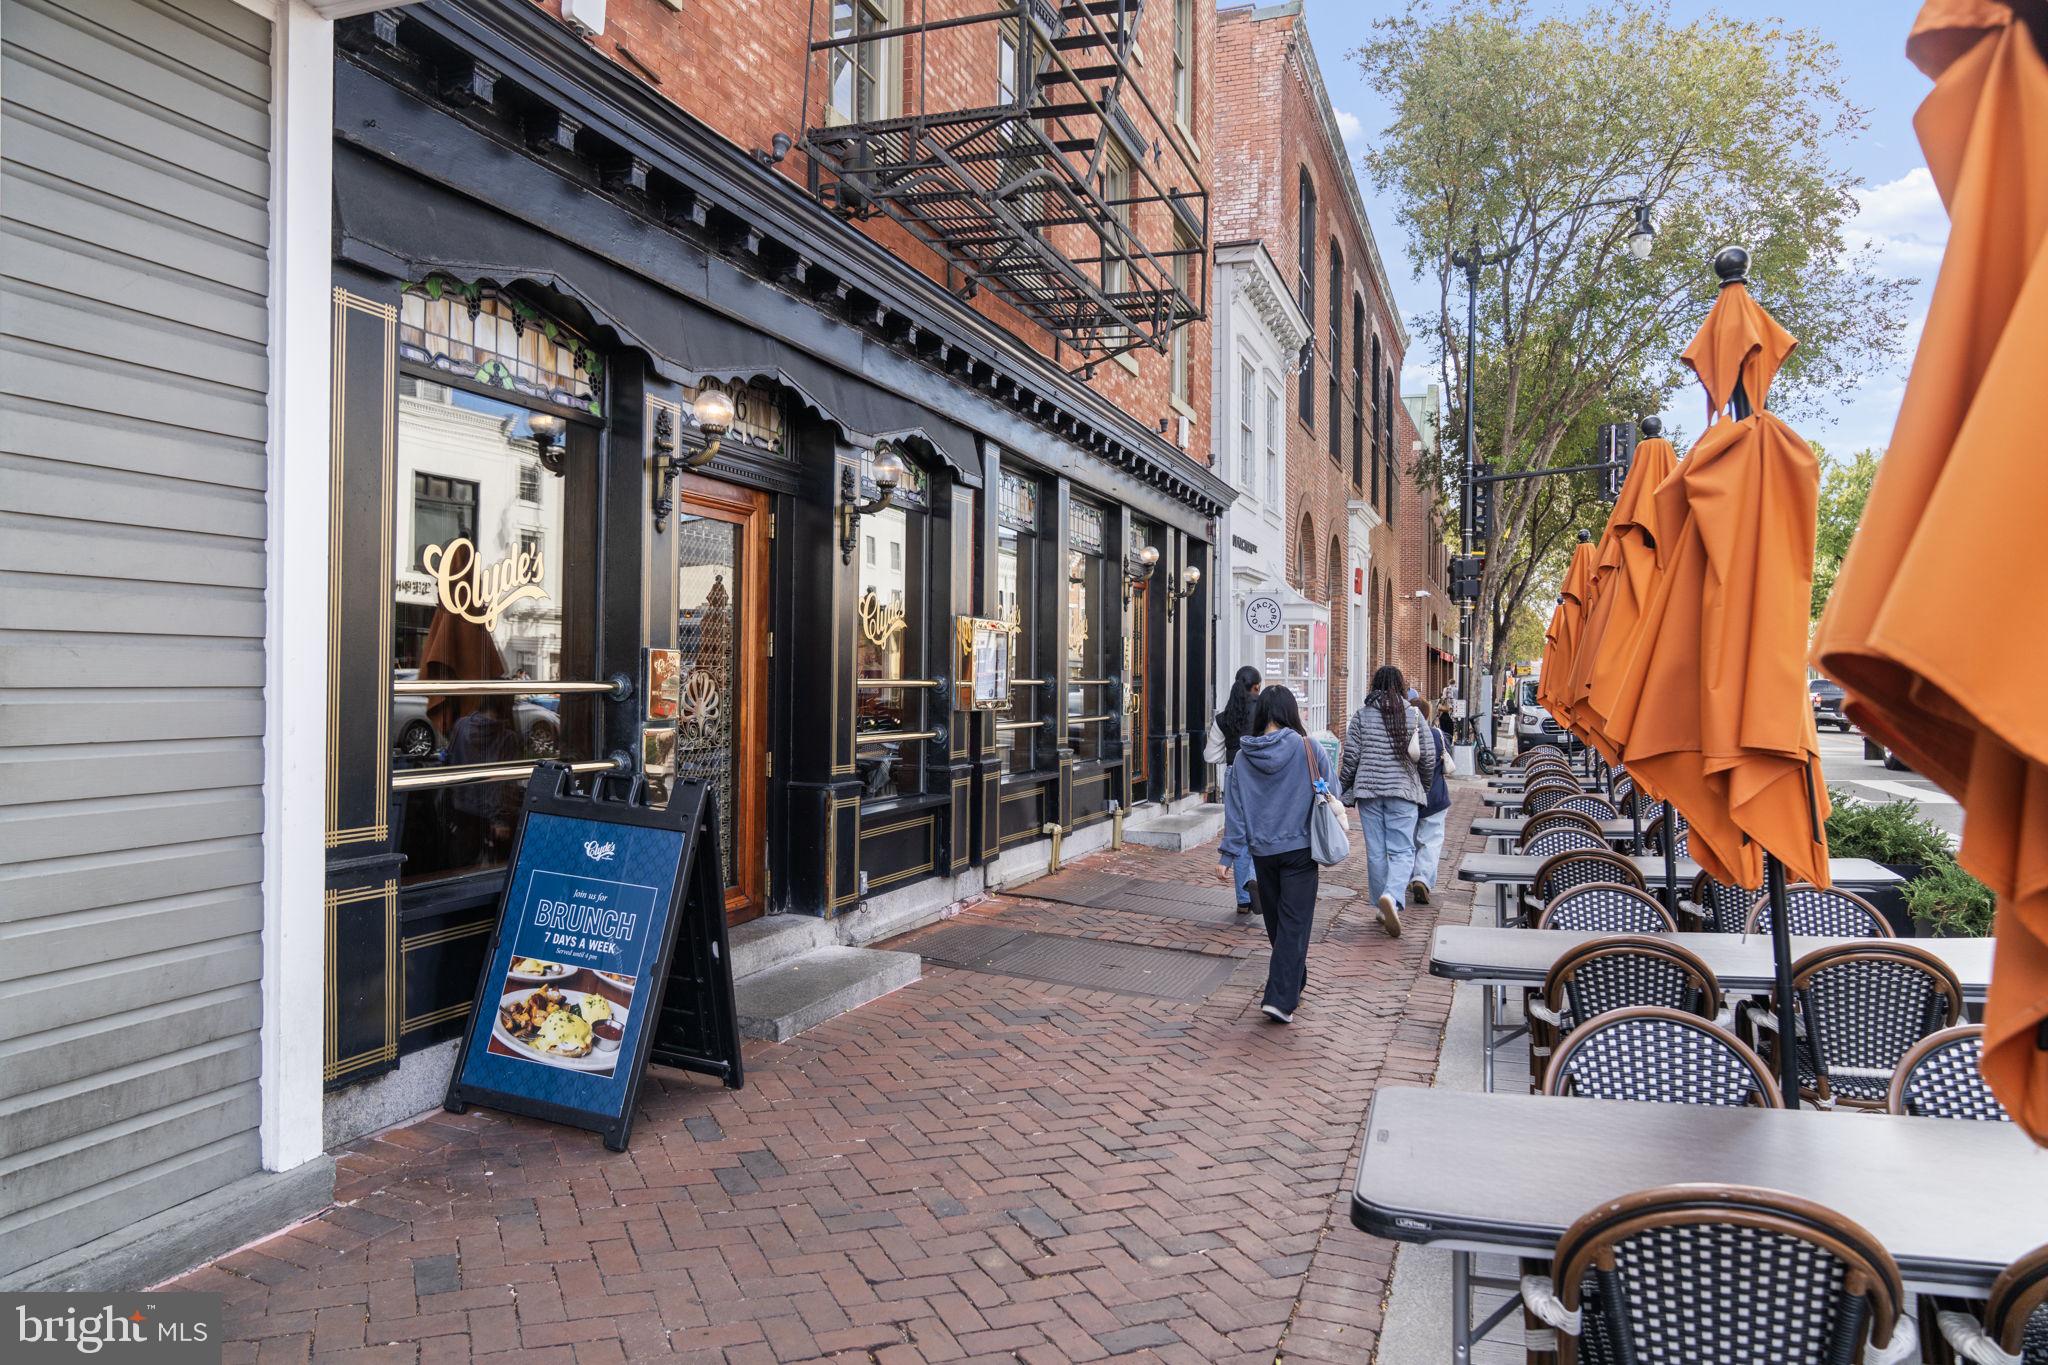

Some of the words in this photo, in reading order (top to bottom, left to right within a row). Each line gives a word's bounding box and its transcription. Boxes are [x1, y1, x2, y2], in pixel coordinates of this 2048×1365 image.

[423, 538, 551, 632] Clyde's
[1251, 601, 1277, 625] OLFACTORY
[584, 840, 616, 861] Clyde's
[573, 889, 587, 899] Join
[595, 892, 608, 903] for
[534, 899, 637, 941] BRUNCH
[544, 932, 551, 943] 7
[552, 933, 577, 947] DAYS
[578, 938, 586, 949] A
[588, 939, 616, 954] WEEK
[555, 947, 573, 955] Served
[572, 950, 585, 958] until
